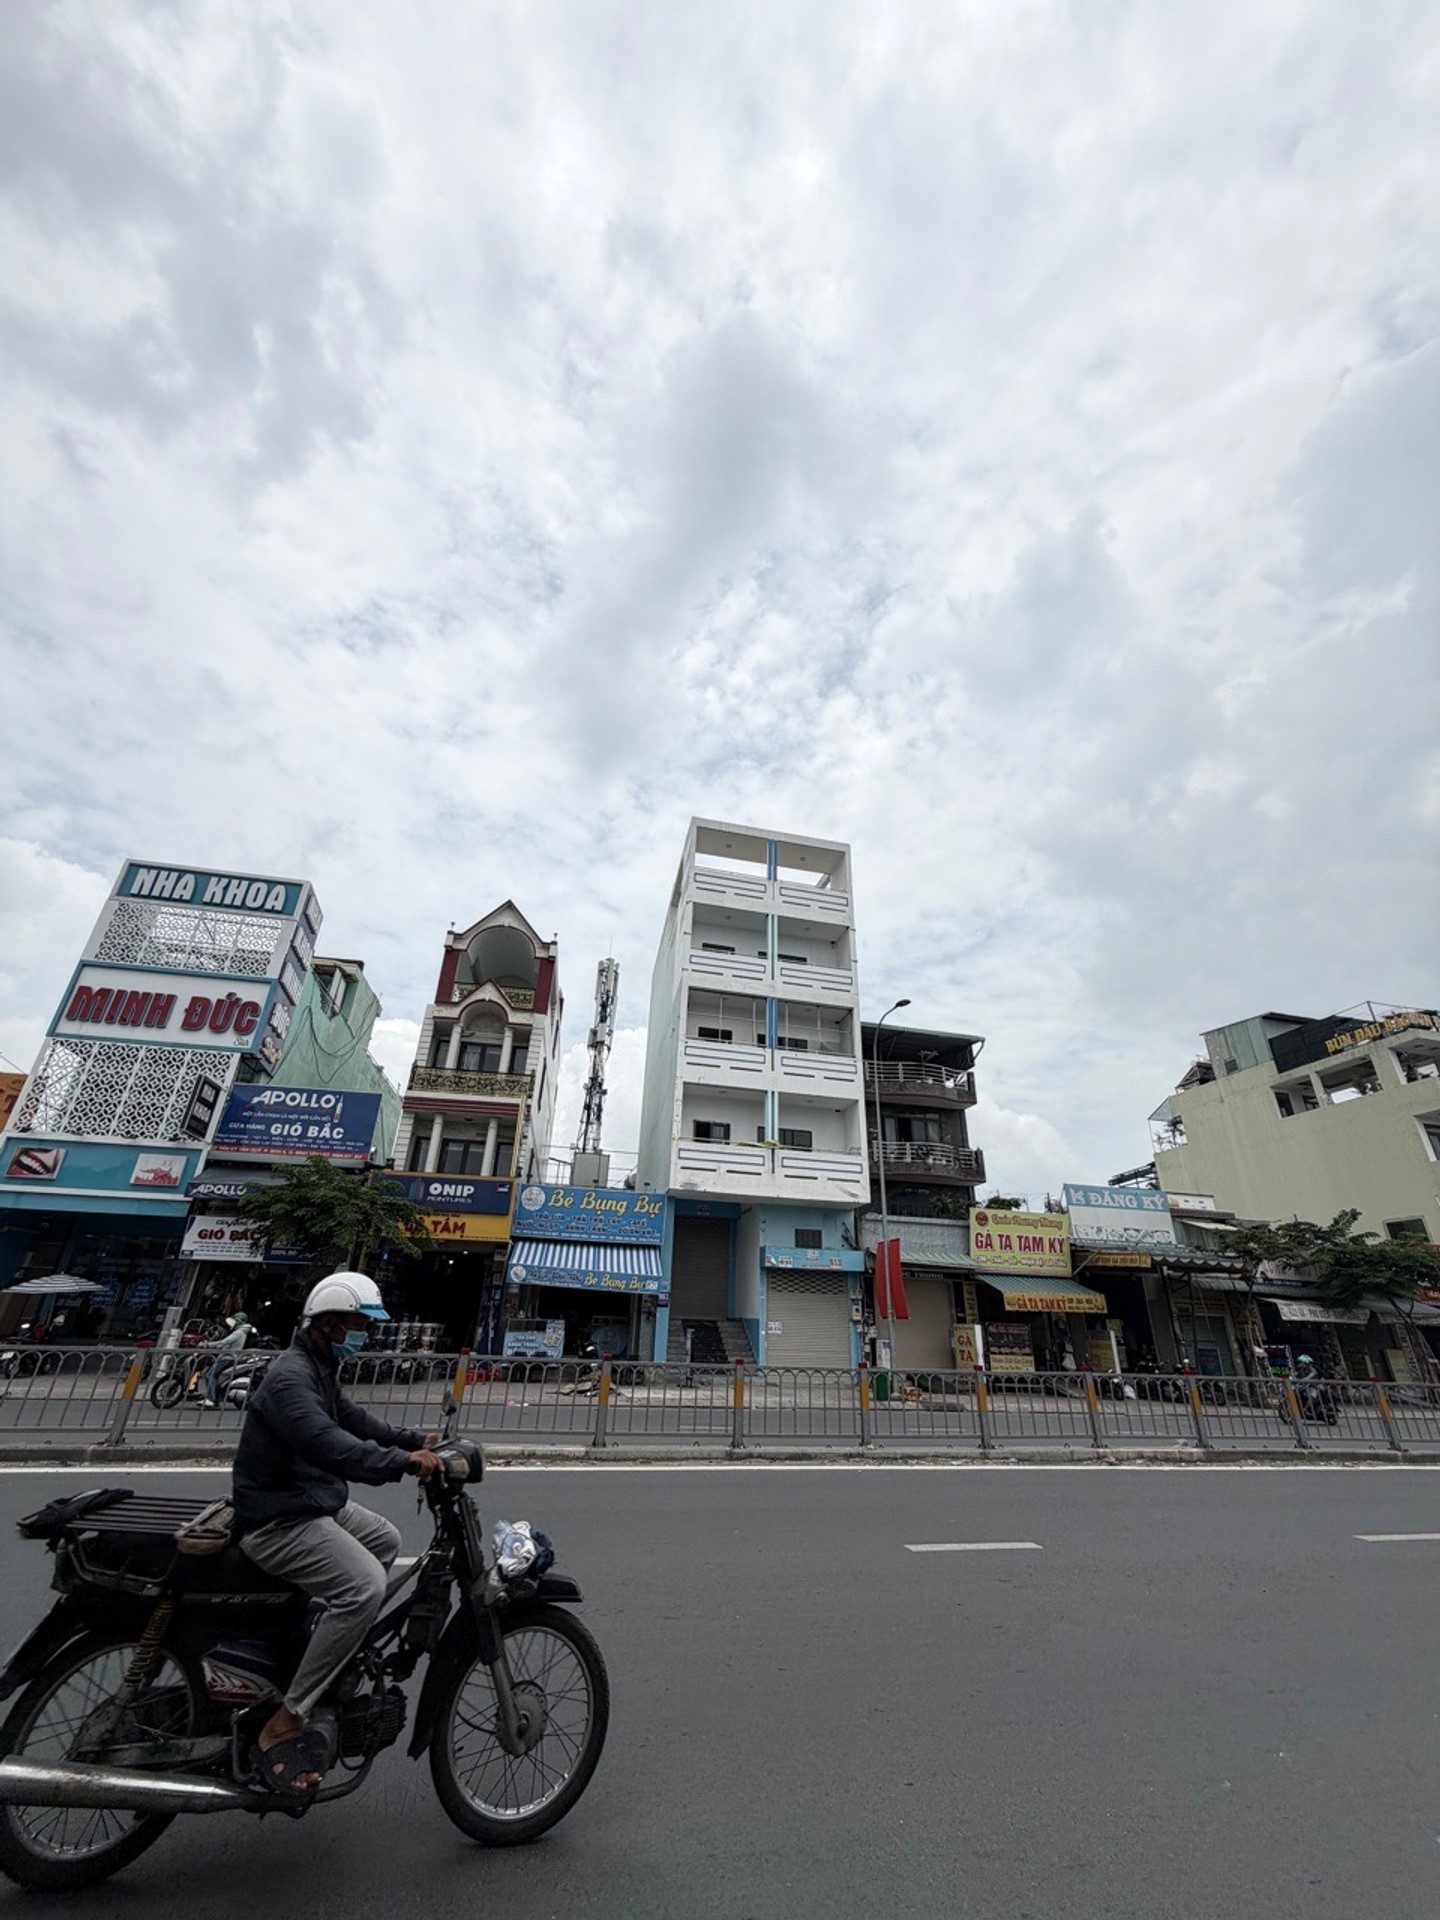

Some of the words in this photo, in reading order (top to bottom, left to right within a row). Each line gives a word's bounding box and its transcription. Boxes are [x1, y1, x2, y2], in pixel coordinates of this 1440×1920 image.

[130, 868, 197, 901] NHA
[203, 876, 287, 912] KHOA
[65, 985, 178, 1030] MINH
[181, 991, 262, 1036] ĐỨC
[251, 1090, 336, 1109] APOLLO
[270, 1121, 303, 1137] GIÓ
[307, 1122, 345, 1140] BẮC
[429, 1182, 475, 1197] ONIP
[548, 1189, 574, 1207] Bé
[580, 1191, 627, 1216] Bụng
[633, 1195, 662, 1218] Bự
[1088, 1190, 1138, 1208] ĐĂNG
[1141, 1193, 1165, 1210] KÝ
[197, 1227, 225, 1241] GIÓ
[975, 1229, 993, 1250] GÀ
[997, 1233, 1013, 1251] TA
[1017, 1235, 1044, 1253] TAM
[959, 1349, 974, 1363] TA
